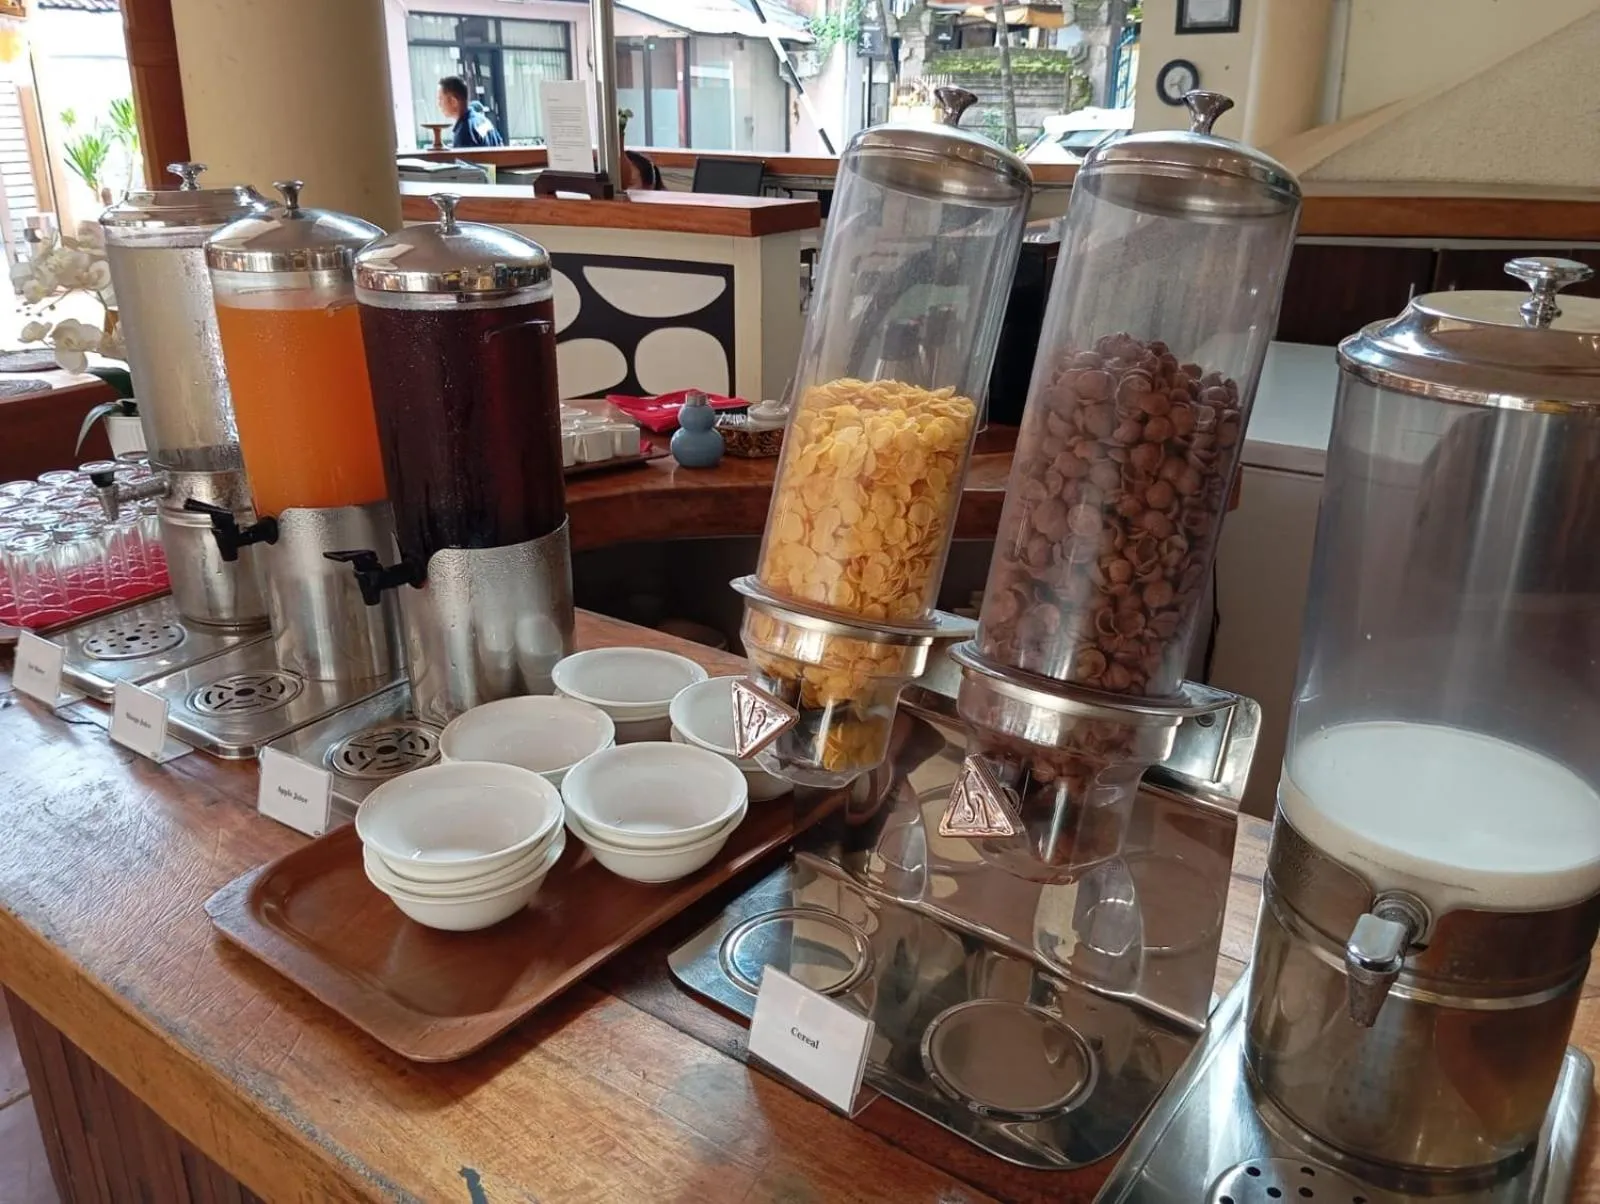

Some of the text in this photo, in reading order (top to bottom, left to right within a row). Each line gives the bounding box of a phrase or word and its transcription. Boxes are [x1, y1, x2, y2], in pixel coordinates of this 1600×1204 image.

[278, 785, 308, 803] Apple Juice
[790, 1026, 820, 1050] Cereal
